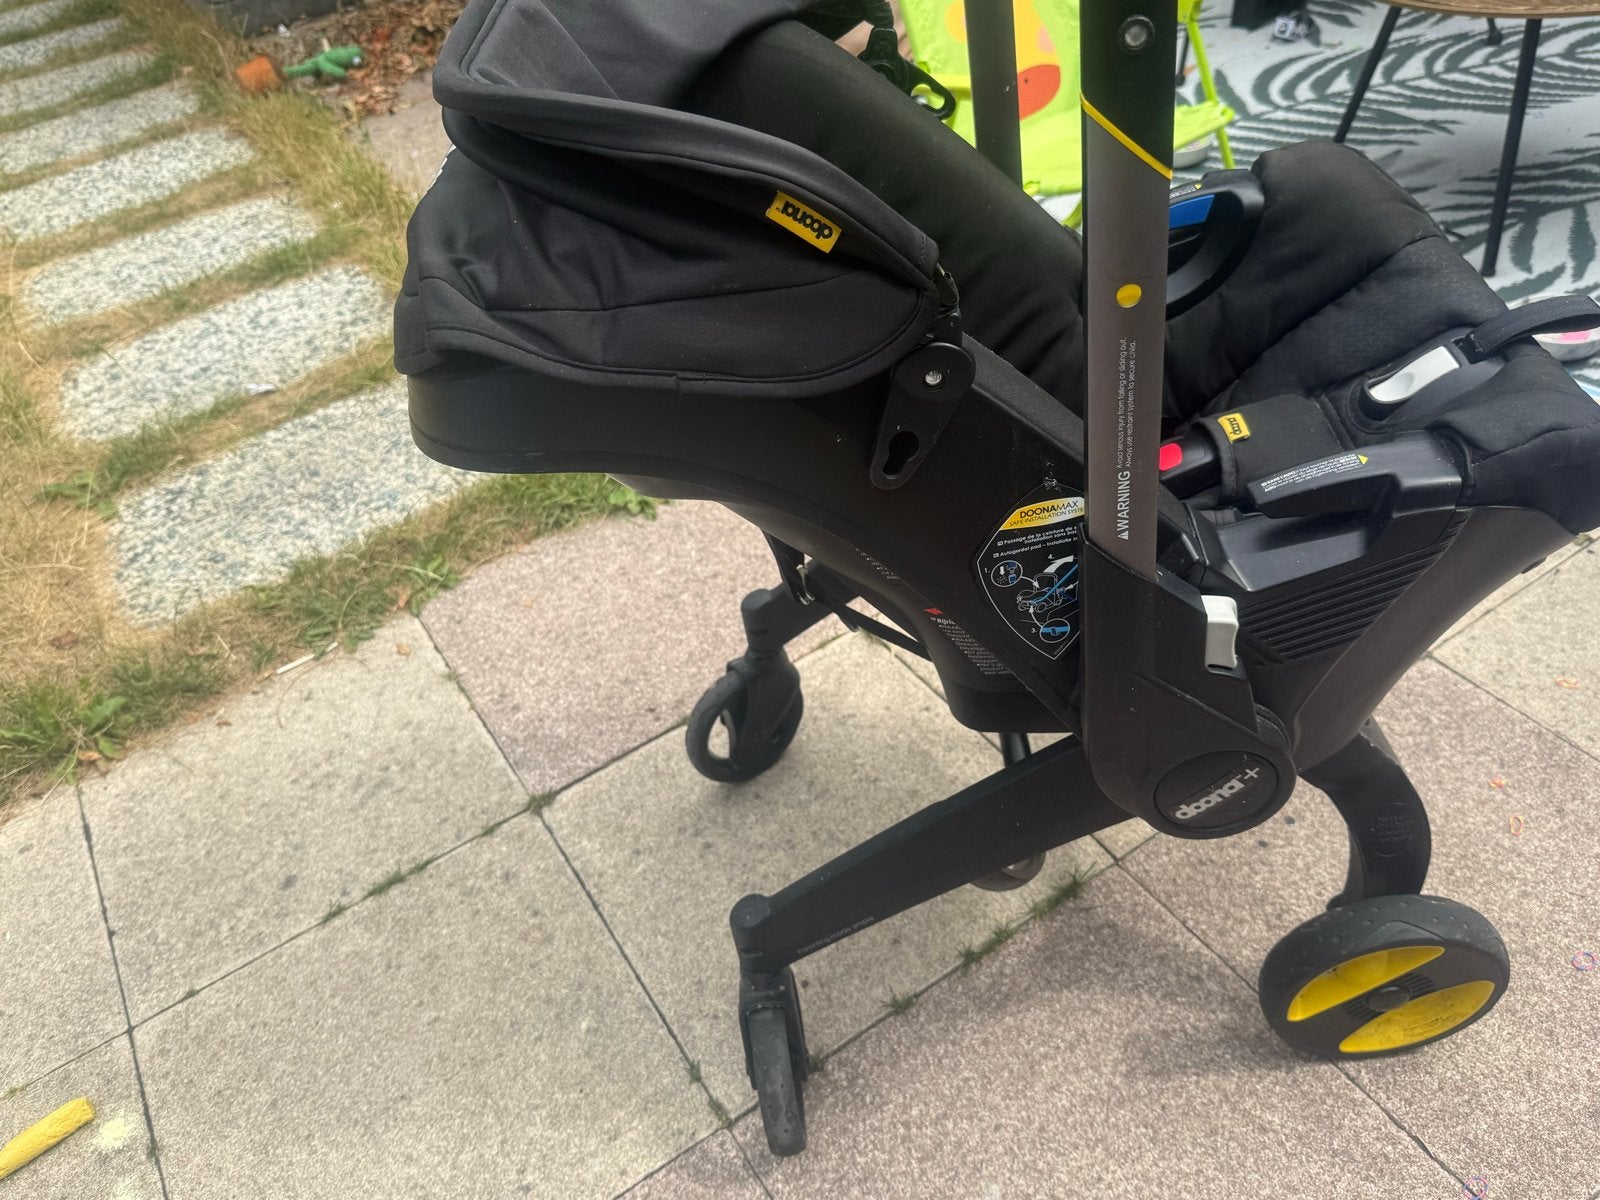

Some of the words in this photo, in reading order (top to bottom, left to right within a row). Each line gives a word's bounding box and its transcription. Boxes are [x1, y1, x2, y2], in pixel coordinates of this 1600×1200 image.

[781, 201, 833, 240] doona
[1119, 351, 1127, 371] sliding
[1127, 390, 1136, 411] system
[1126, 412, 1134, 435] restraint
[1020, 500, 1079, 519] DOONAMAX
[1117, 470, 1130, 531] WARNING
[1025, 511, 1067, 524] INSTALLATION
[1004, 536, 1027, 545] Passage
[1042, 528, 1064, 537] ceinture
